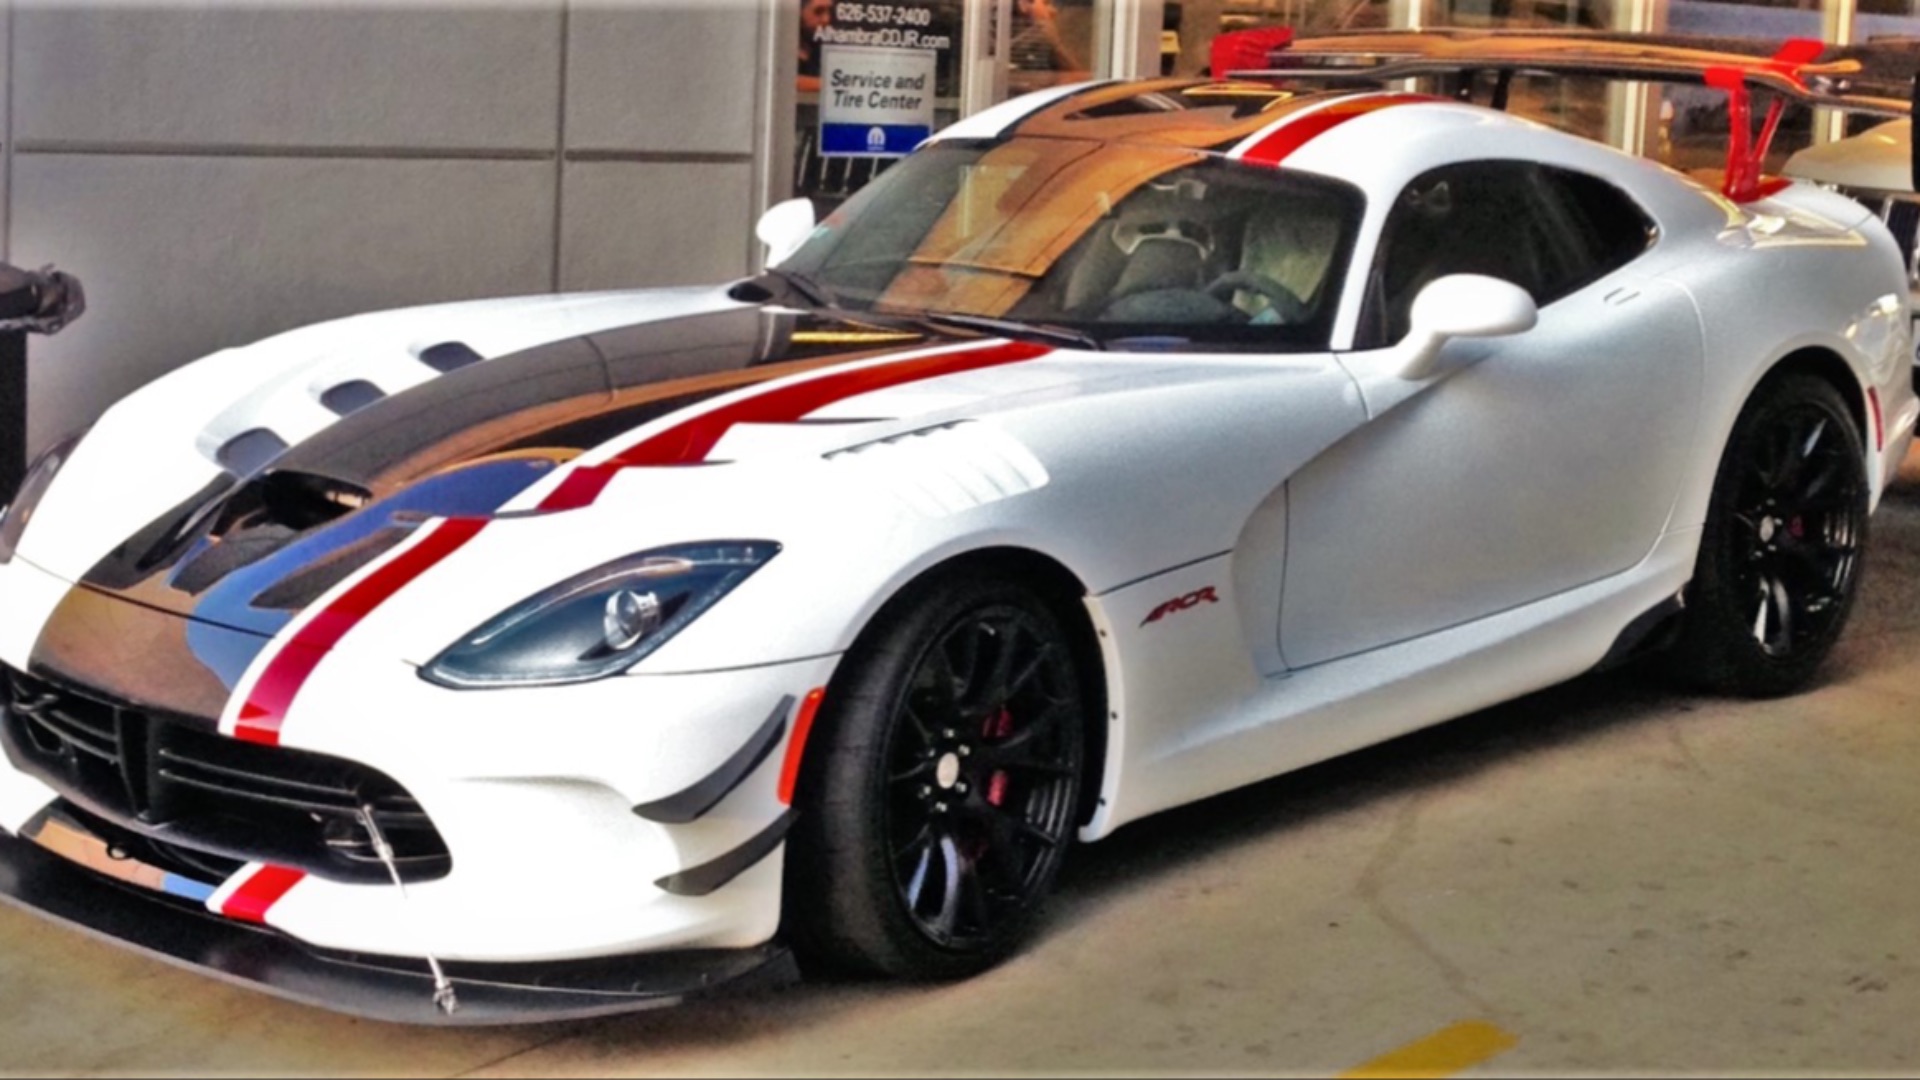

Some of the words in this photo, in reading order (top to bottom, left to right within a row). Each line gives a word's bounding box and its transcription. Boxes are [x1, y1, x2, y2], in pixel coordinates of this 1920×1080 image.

[835, 2, 931, 26] 626-537-2400
[831, 69, 891, 89] Service
[895, 73, 926, 91] and
[833, 90, 864, 108] Tire
[867, 91, 922, 110] Center
